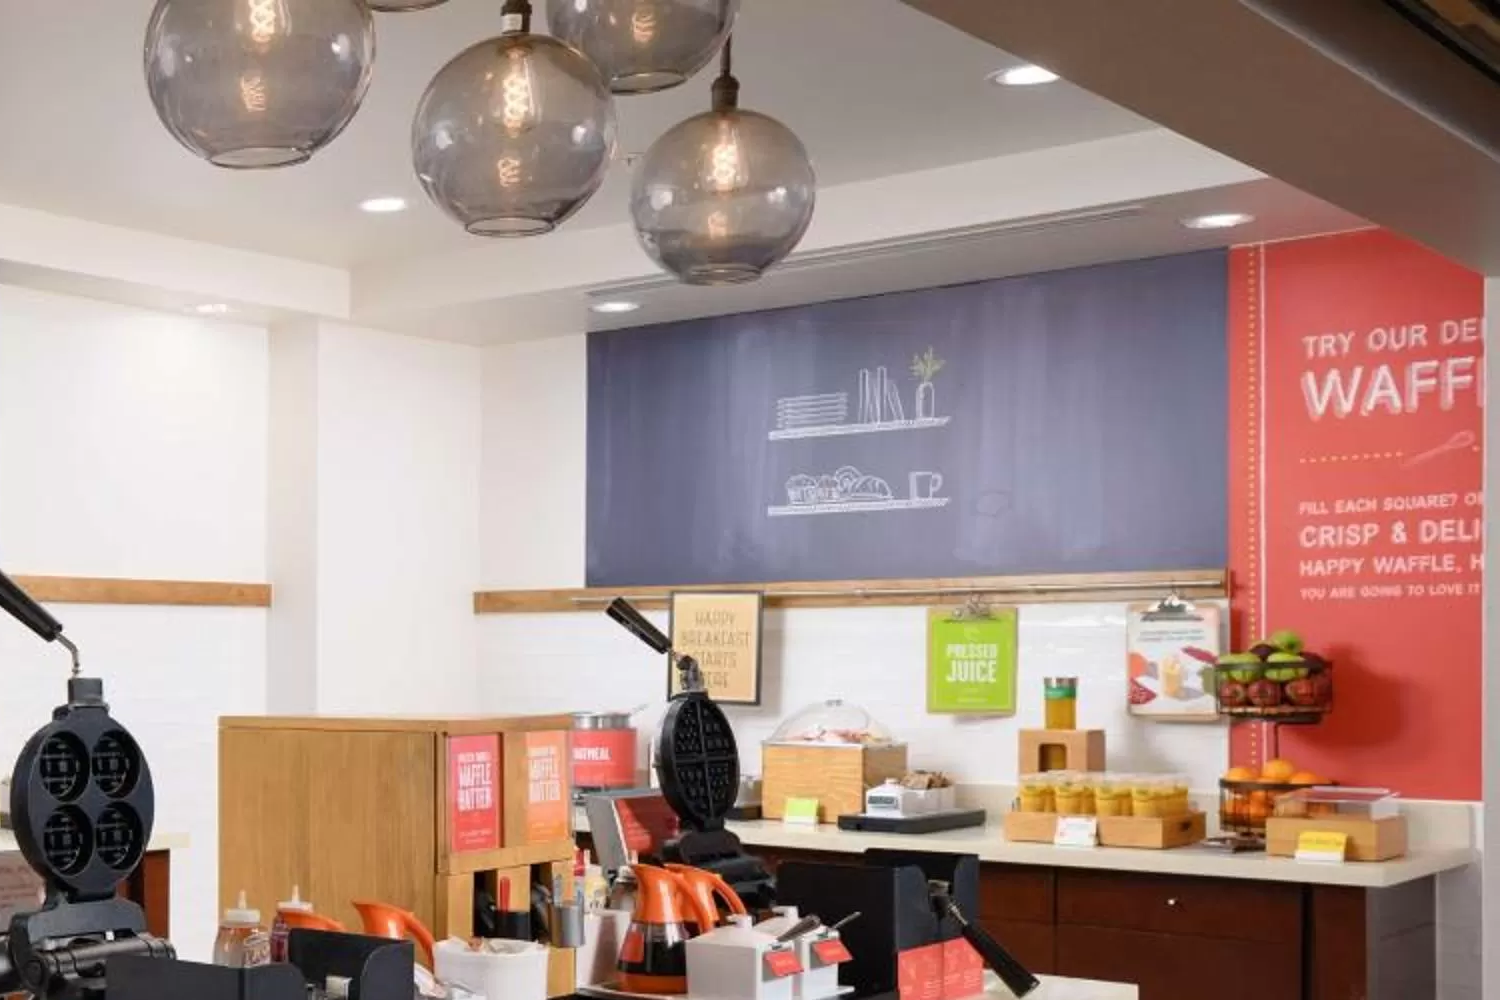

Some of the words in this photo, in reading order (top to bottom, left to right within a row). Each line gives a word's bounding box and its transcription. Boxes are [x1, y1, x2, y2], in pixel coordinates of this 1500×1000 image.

[1301, 331, 1355, 359] TRY
[1367, 324, 1428, 351] OUR
[1441, 317, 1485, 345] DE
[1301, 356, 1484, 422] WAFF
[1299, 500, 1329, 516] FILL
[1335, 498, 1377, 514] EACH
[1383, 493, 1458, 511] SQUARE?
[1300, 522, 1380, 548] CRISP
[1391, 520, 1408, 545] &
[1300, 557, 1366, 577] HAPPY
[1300, 587, 1325, 601] YOU
[1329, 586, 1356, 600] ARE
[1360, 584, 1403, 598] GOING
[1408, 583, 1425, 597] TO
[1429, 582, 1463, 596] LOVE
[695, 611, 735, 626] HAPPY
[681, 630, 751, 648] BREAKFAST
[946, 643, 997, 659] PRESSED
[946, 660, 997, 683] JUICE
[458, 762, 492, 787] WAFFLE
[457, 786, 493, 812] BATTER
